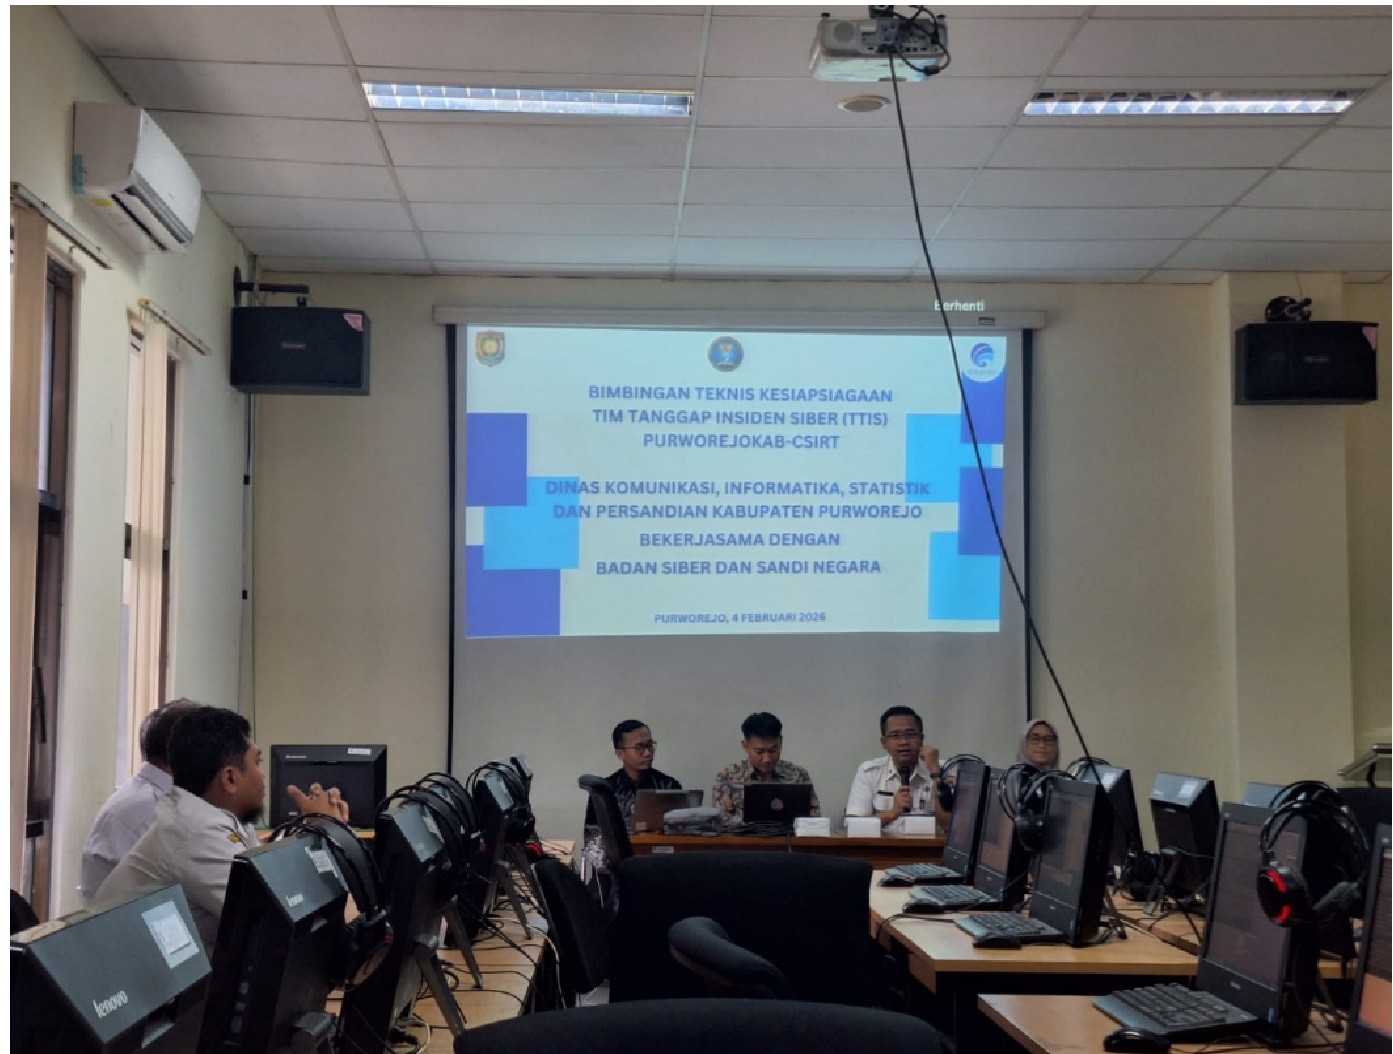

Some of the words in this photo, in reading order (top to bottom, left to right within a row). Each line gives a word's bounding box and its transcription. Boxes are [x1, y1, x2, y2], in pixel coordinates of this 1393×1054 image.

[589, 385, 690, 399] BIMBINGAN
[695, 386, 755, 400] TEKNIS
[760, 388, 893, 402] KESIAPSIAGAAN
[592, 409, 623, 422] TIM
[628, 410, 711, 424] TANGGAP
[716, 411, 785, 425] INSIDEN
[790, 412, 838, 426] SIBER
[842, 412, 888, 427] (TTIS)
[643, 434, 840, 449] PURWOREJOKAB-CSIRT
[546, 481, 599, 495] DINAS
[605, 481, 720, 498] KOMUNIKASI,
[724, 481, 844, 498] INFORMATIKA,
[849, 482, 930, 496] STATISTIK
[553, 505, 591, 518] DAN
[596, 505, 708, 519] PERSANDIAN
[712, 505, 814, 518] KABUPATEN
[819, 505, 923, 519] PURWOREJO
[639, 533, 764, 547] BEKERJASAMA
[769, 533, 840, 546] DENGAN
[596, 561, 657, 575] BADAN
[661, 561, 711, 575] SIBER
[715, 561, 751, 574] DAN
[757, 560, 808, 574] SANDI
[813, 560, 881, 574] NEGARA
[654, 613, 729, 624] PURWOREJO,
[732, 613, 738, 623] 4
[741, 613, 796, 623] FEBRUARI
[799, 612, 826, 622] 2026
[93, 990, 128, 1019] lenovo
